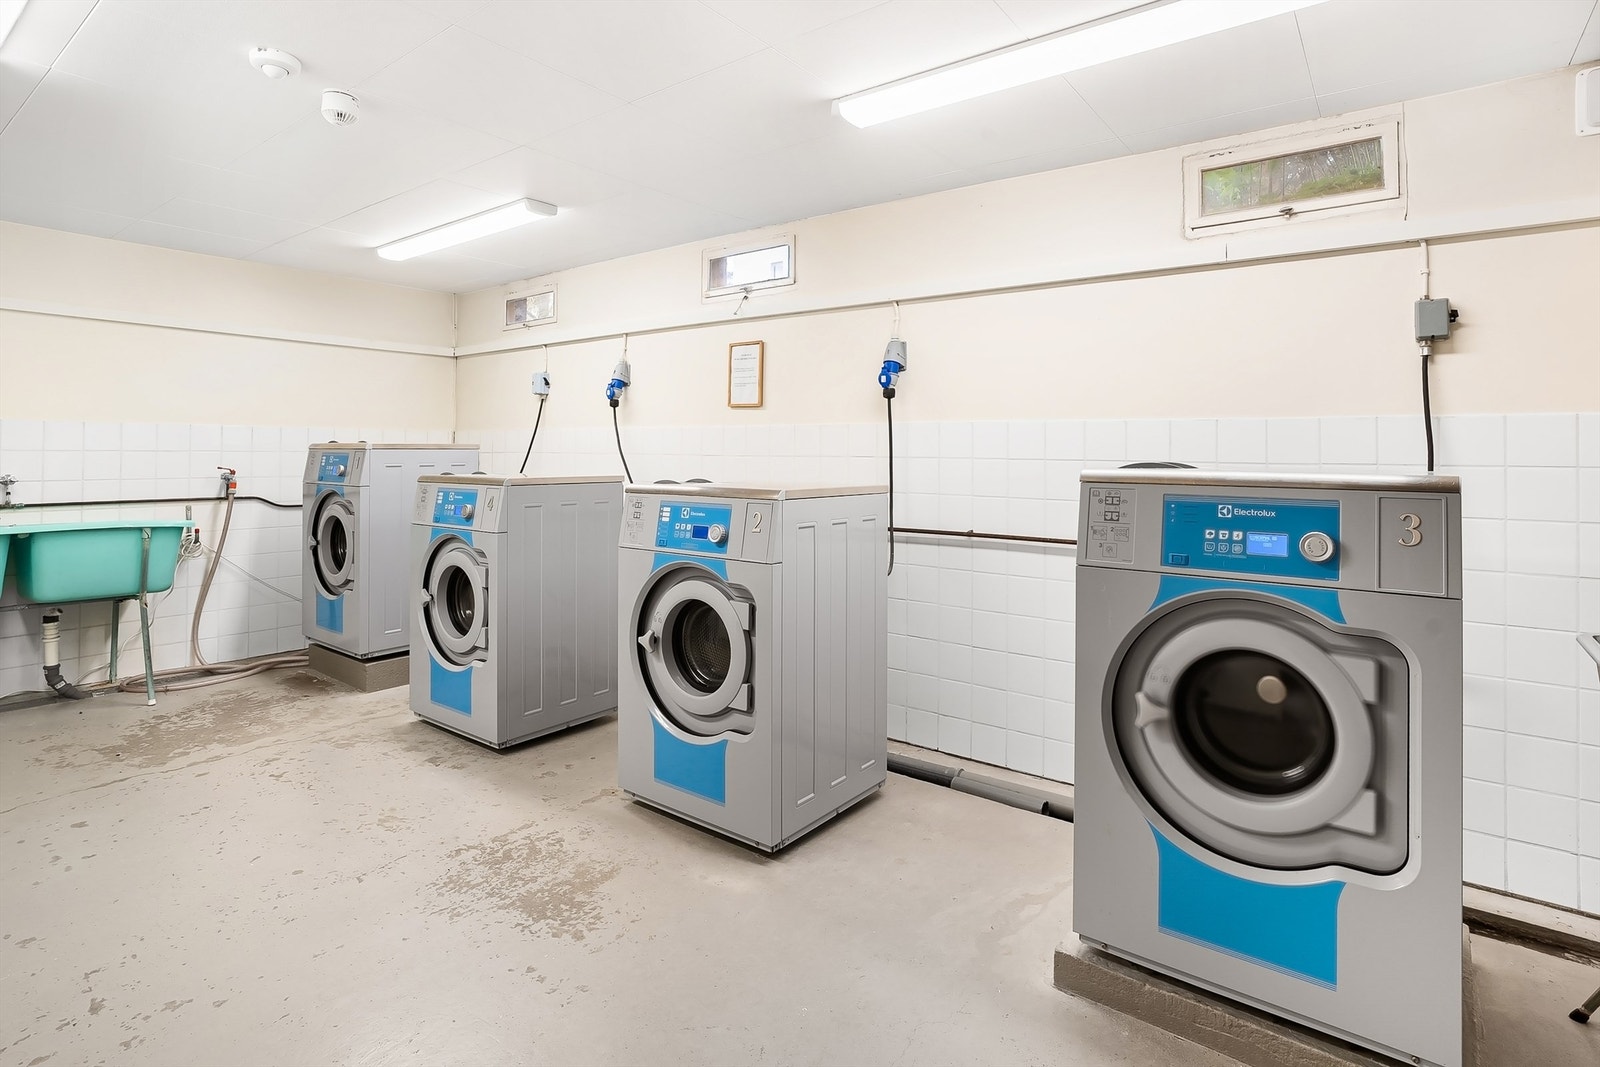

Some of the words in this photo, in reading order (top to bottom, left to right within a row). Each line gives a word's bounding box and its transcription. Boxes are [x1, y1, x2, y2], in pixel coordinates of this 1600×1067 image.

[487, 496, 494, 512] 4
[1234, 508, 1276, 517] Electrolux
[751, 511, 763, 534] 2
[1398, 513, 1423, 547] 3
